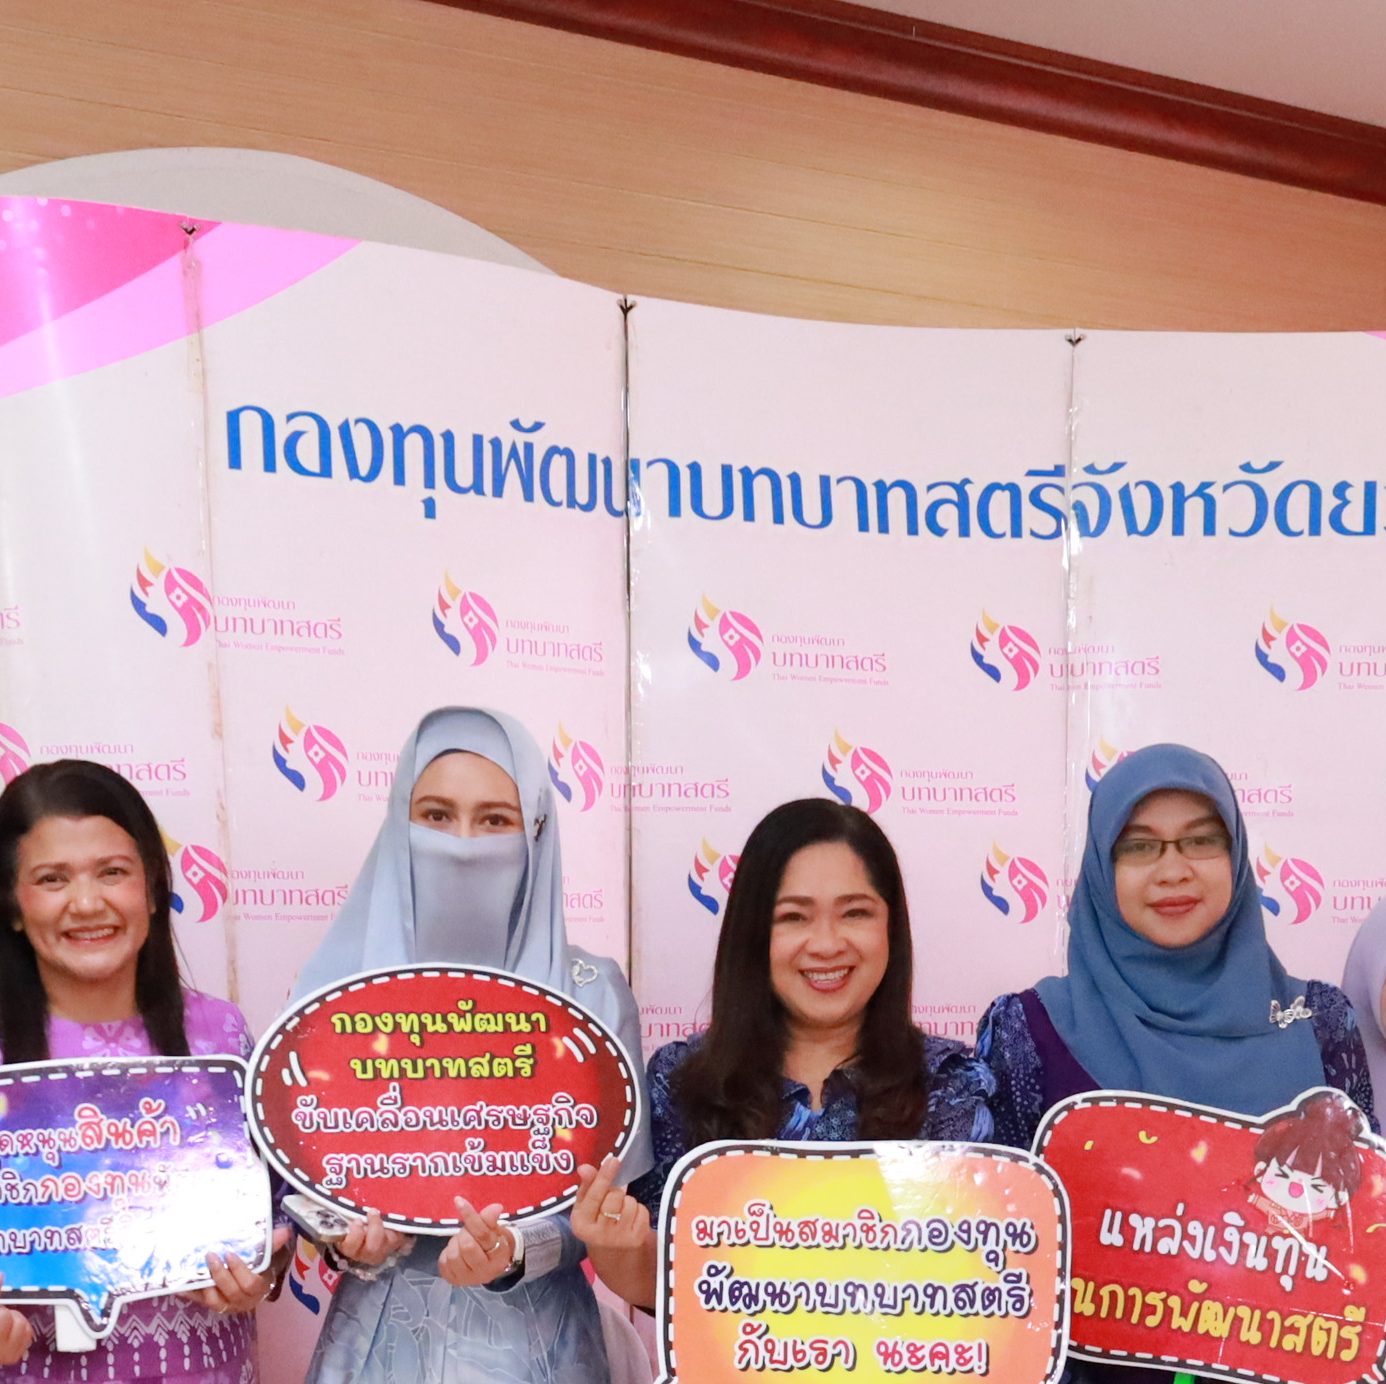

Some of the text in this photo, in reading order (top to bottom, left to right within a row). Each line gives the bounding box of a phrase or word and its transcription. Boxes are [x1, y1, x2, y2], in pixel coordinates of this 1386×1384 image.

[214, 615, 343, 640] บทบาทสตรี
[506, 637, 603, 662] บทบาทสตรี
[772, 651, 887, 673] บทบาทสตรี
[901, 783, 1016, 803] บทบาทสตรี
[330, 999, 547, 1045] กองทุนพัฒนา
[350, 1044, 534, 1080] บทบาทสตรี
[293, 1084, 597, 1137] ขับเคลื่อนเศรษฐกิจ
[323, 1137, 575, 1189] ฐานรากเข้มแข็ง
[694, 1202, 1035, 1267] มาเป็นสมาชิกกองทุน
[1099, 1203, 1329, 1292] แหล่งเงินทุน
[698, 1264, 1031, 1316] พัฒนาบทบาทสตรี
[1071, 1277, 1367, 1362] นการพัฒนาสตรี
[737, 1323, 988, 1374] กับเรา นะคะ!
